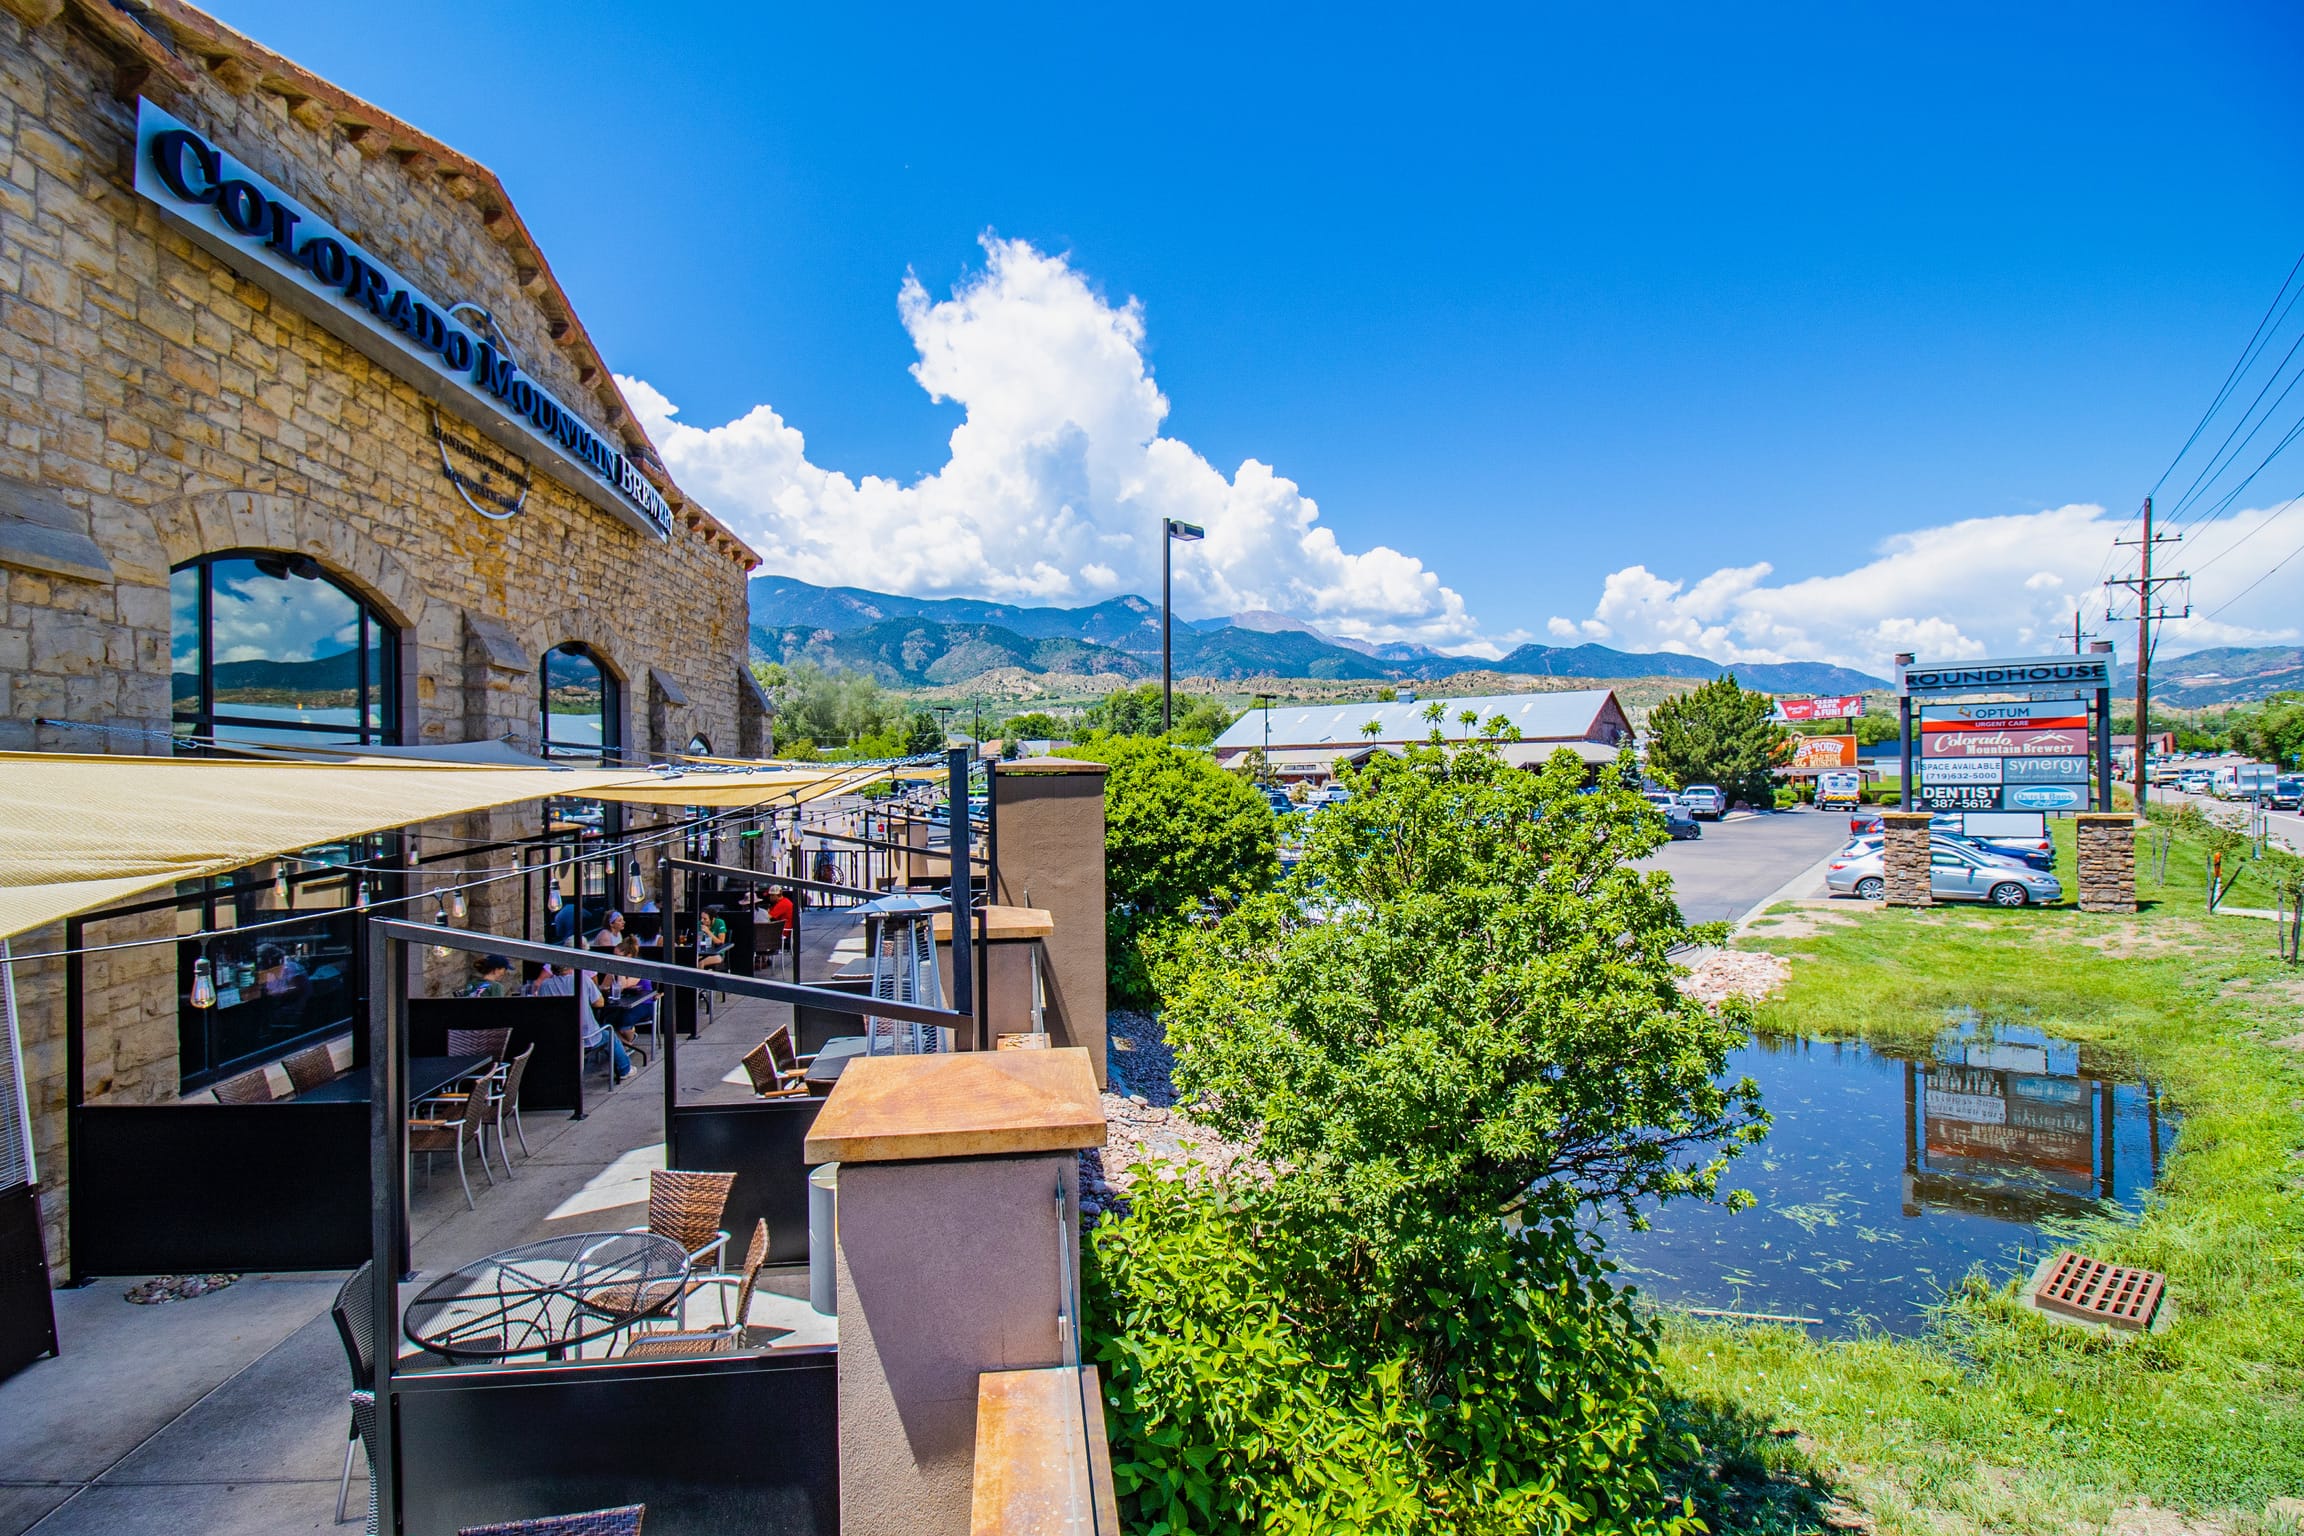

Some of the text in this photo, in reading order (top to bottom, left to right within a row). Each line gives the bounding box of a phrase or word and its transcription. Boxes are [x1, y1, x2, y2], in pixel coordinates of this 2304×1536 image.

[152, 129, 675, 536] COLORADO MOUNTAIN BREWERY
[1905, 664, 2107, 686] ROUNDHOUSE
[1975, 708, 2030, 719] OPTUM
[1975, 720, 2006, 728] URGENT
[1934, 731, 2012, 753] Colorado
[1966, 743, 2075, 755] Mountain Brewery
[1921, 762, 2001, 771] SPACE AVAILABLE
[2008, 759, 2083, 774] synergy
[1926, 772, 1997, 780] (719)632-5000
[1922, 786, 2001, 799] DENTIST
[1931, 799, 1993, 809] 387-5612
